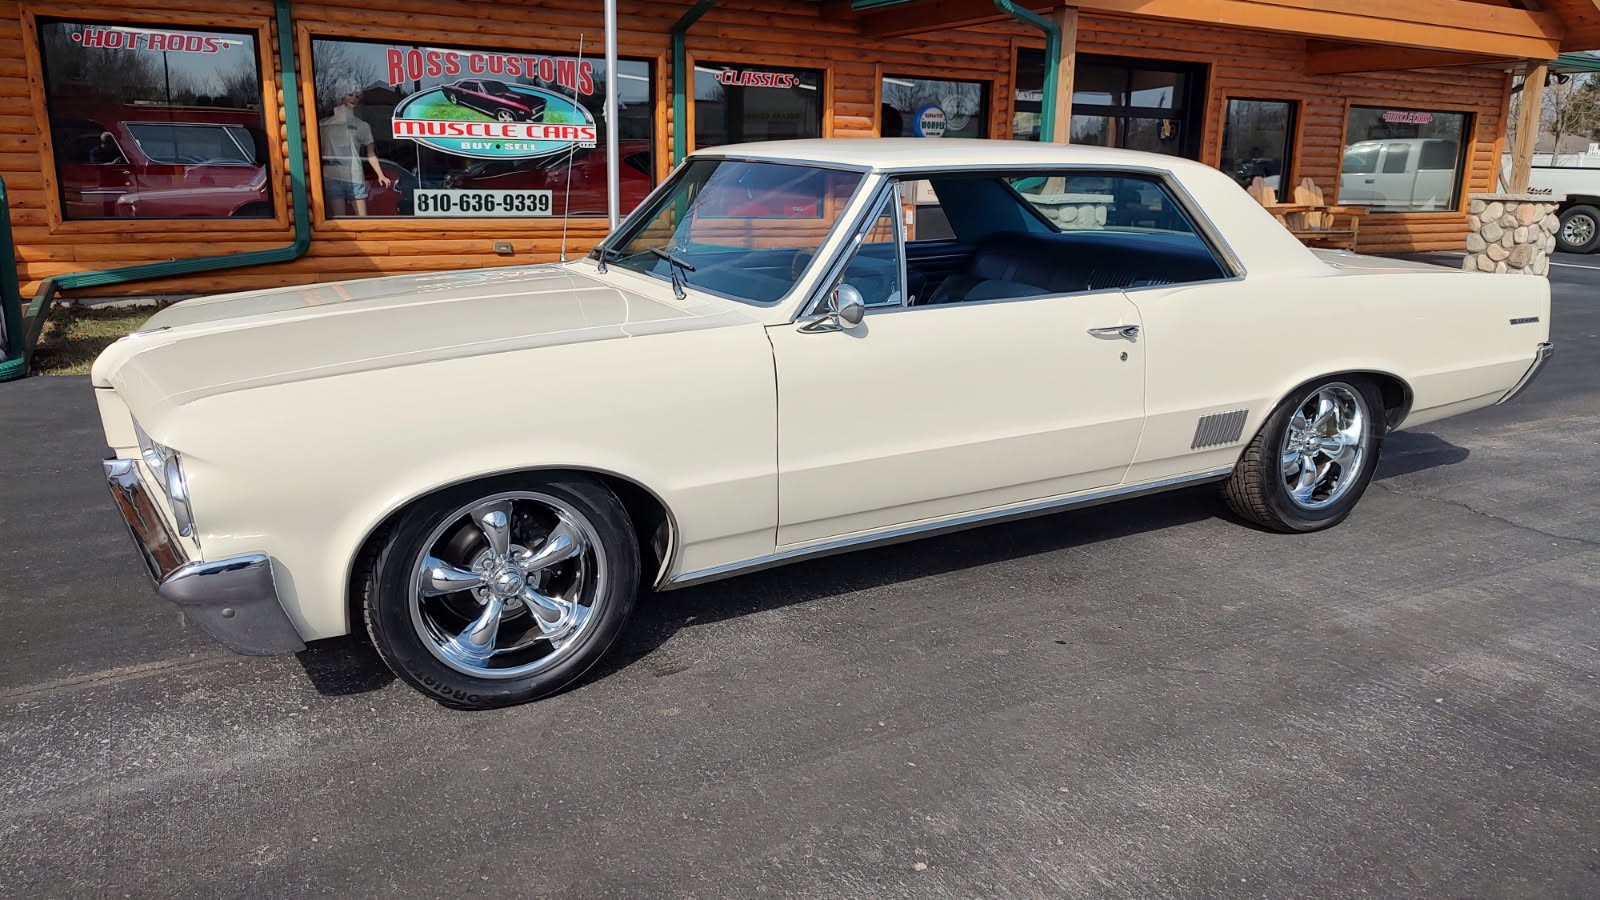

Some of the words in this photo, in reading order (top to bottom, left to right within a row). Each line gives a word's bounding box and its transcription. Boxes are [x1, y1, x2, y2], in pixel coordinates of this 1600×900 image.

[82, 28, 143, 49] HOT
[148, 33, 220, 53] RODS
[386, 48, 461, 87] ROSS
[468, 53, 594, 96] CUSTOMS
[720, 69, 795, 89] CLASSICS
[393, 121, 519, 138] MUSCLE
[526, 125, 596, 140] CARS
[460, 142, 493, 150] BUY
[504, 143, 538, 151] SELL
[417, 193, 550, 212] 810-636-9339
